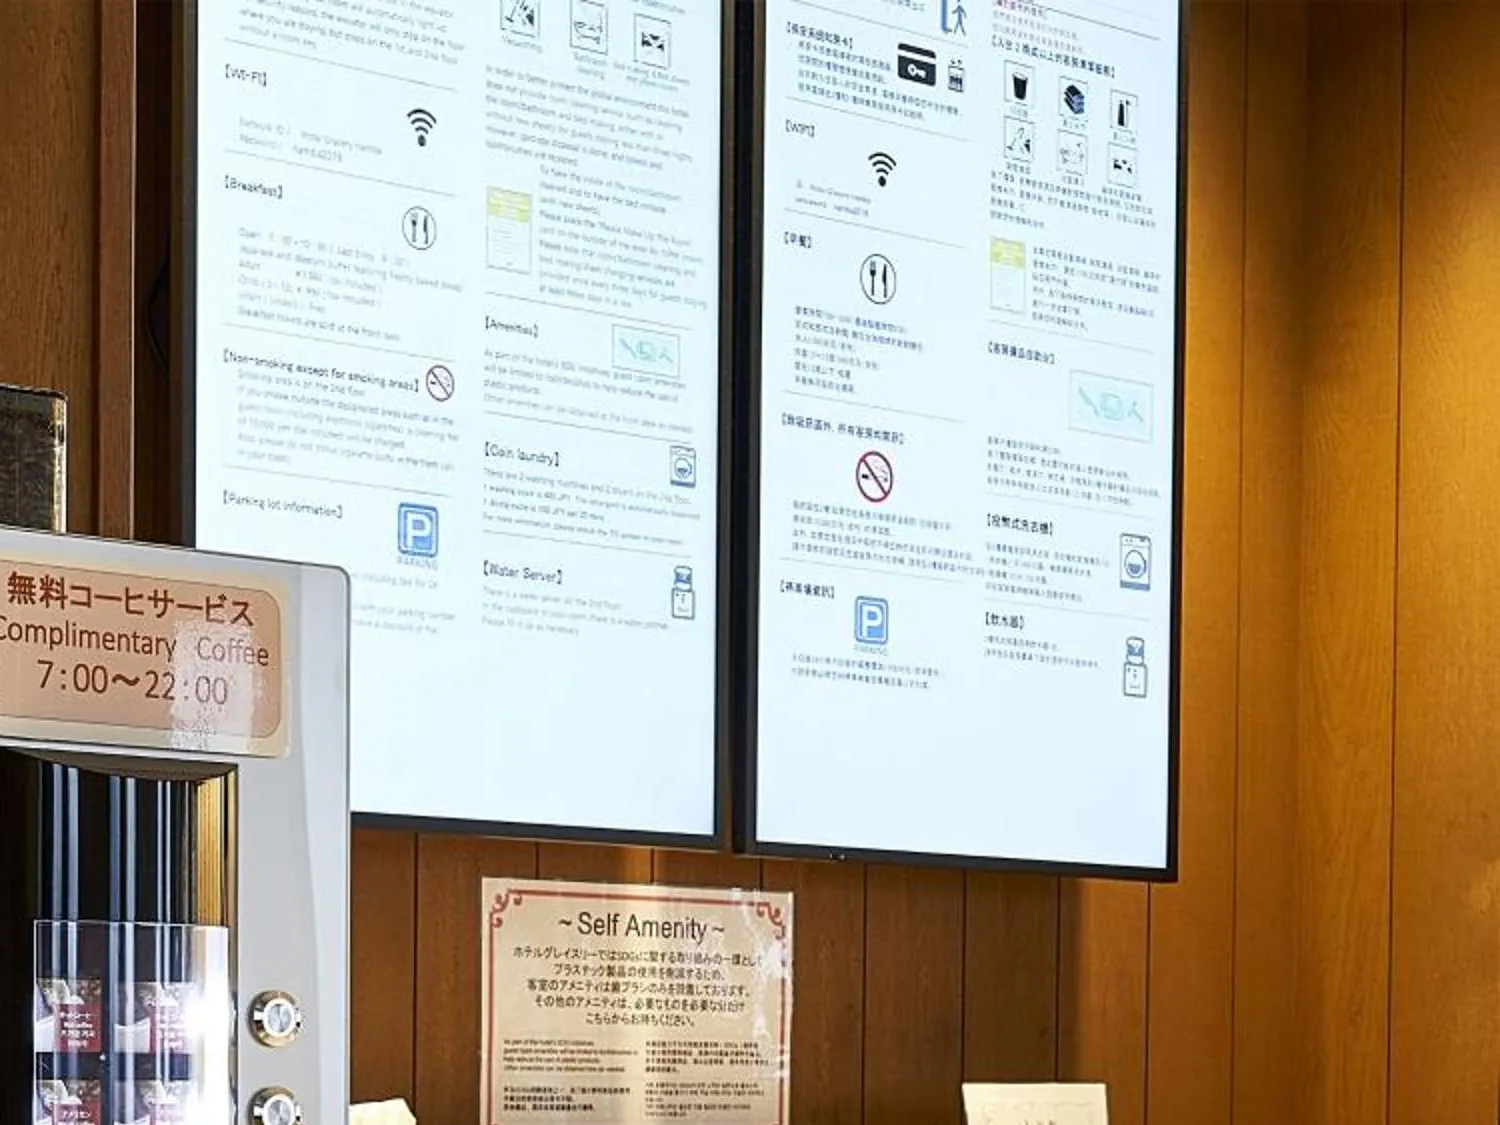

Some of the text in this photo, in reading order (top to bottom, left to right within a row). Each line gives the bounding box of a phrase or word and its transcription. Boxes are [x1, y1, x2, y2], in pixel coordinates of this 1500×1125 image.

[7, 571, 254, 627] 無料コーヒサービス
[196, 636, 270, 667] Coffee
